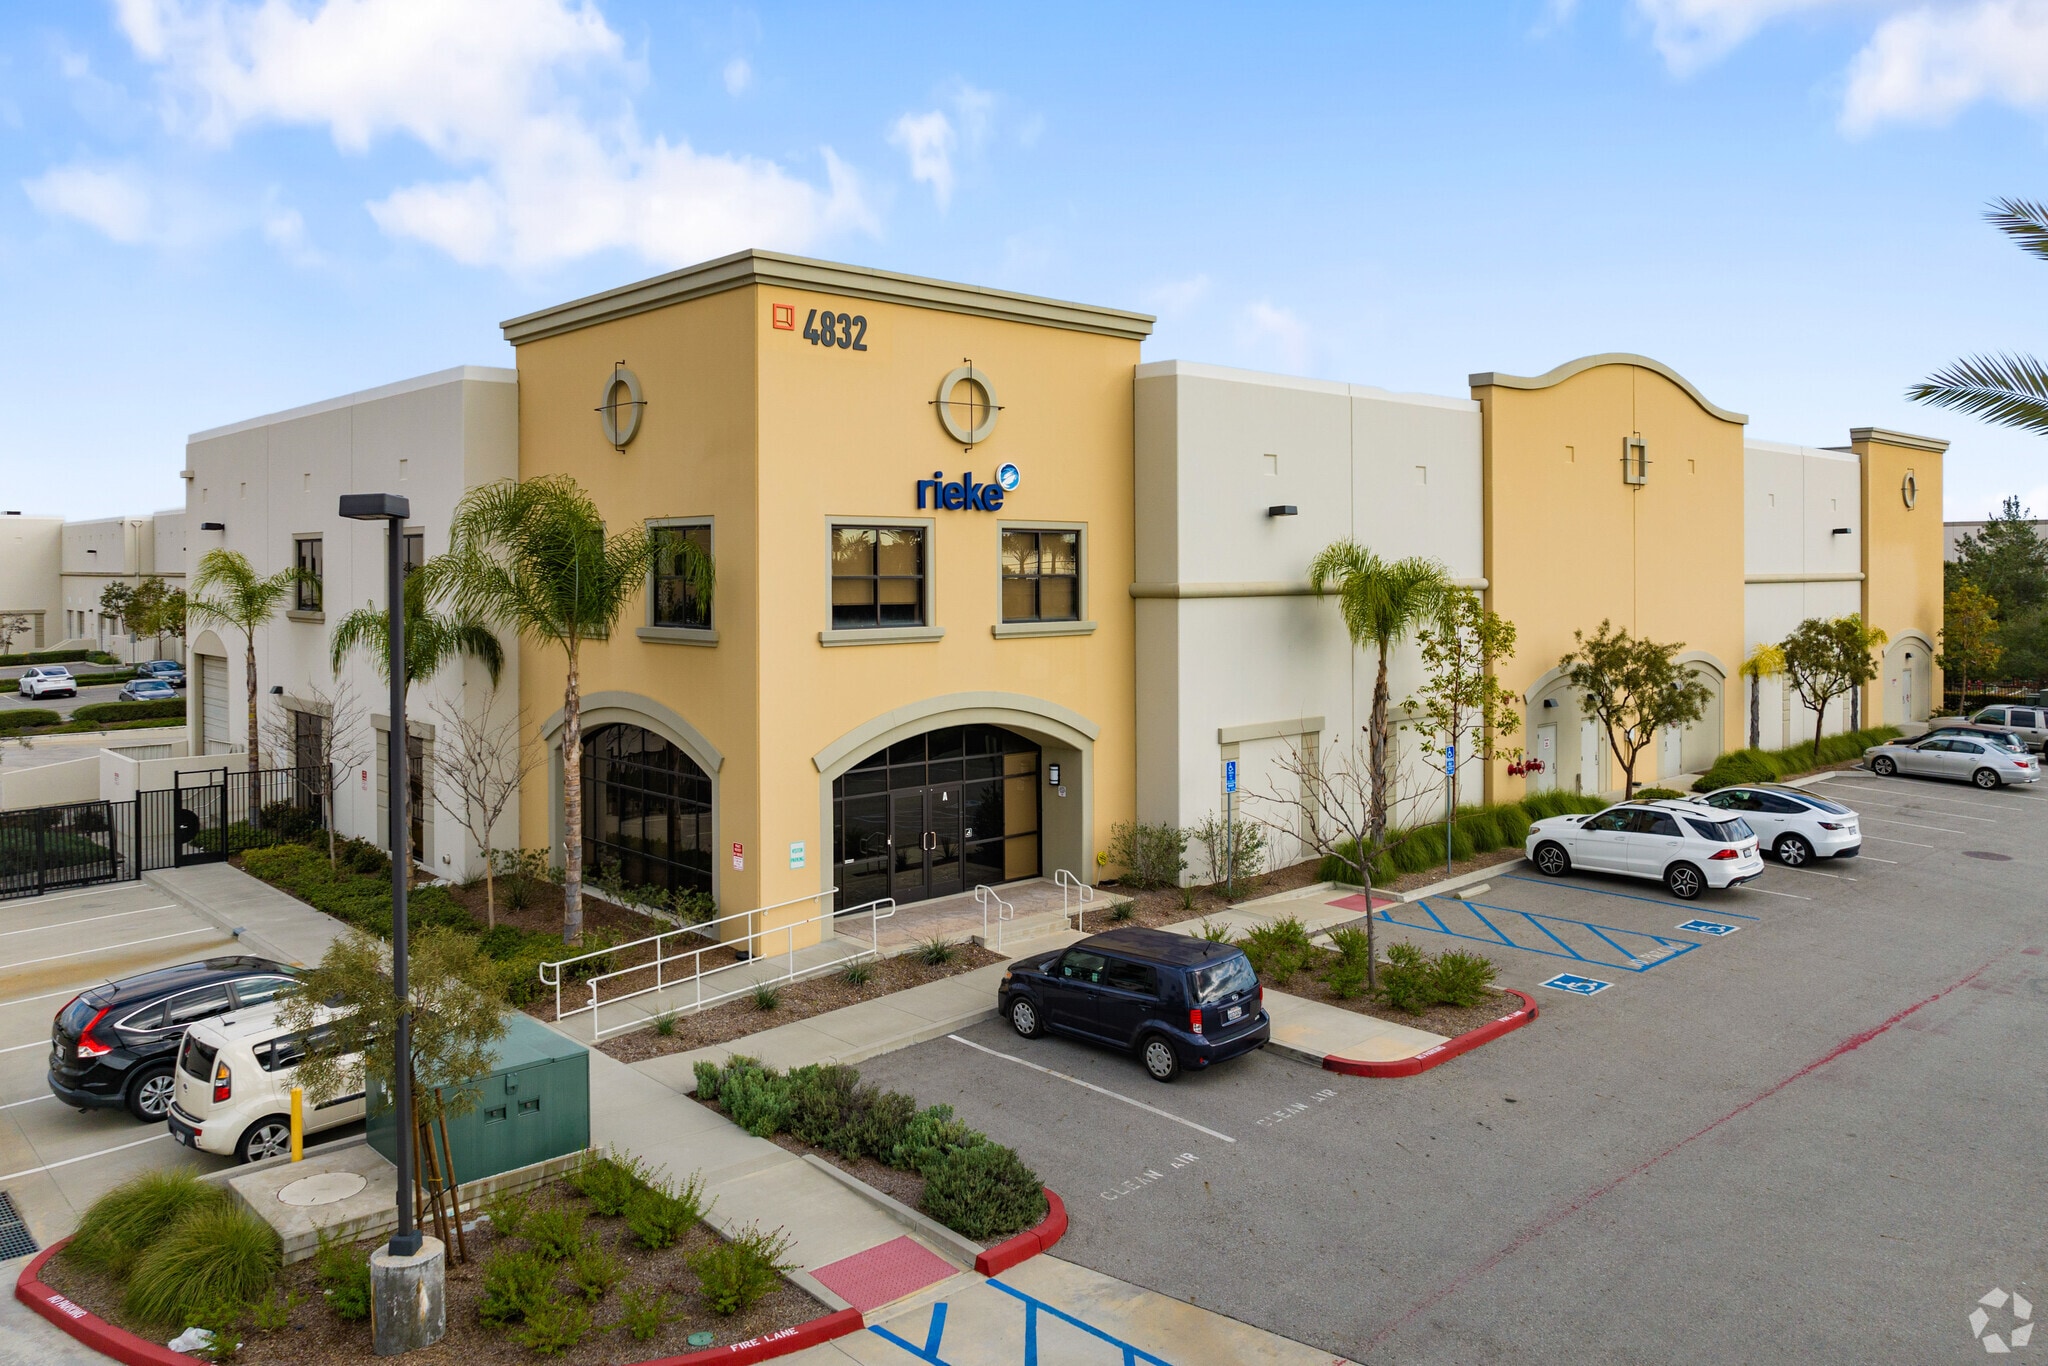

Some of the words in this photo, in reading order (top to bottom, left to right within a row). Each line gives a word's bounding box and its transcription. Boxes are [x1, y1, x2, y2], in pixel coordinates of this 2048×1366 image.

[803, 308, 868, 351] 4832
[917, 471, 1004, 512] rieke
[942, 791, 948, 801] A
[1310, 1088, 1339, 1103] AIR
[1100, 1169, 1164, 1201] CLEAN
[1171, 1152, 1200, 1169] AIR
[46, 1294, 65, 1304] NO
[54, 1299, 88, 1319] PARKING
[729, 1338, 761, 1352] FIRE
[763, 1327, 799, 1342] LANE
